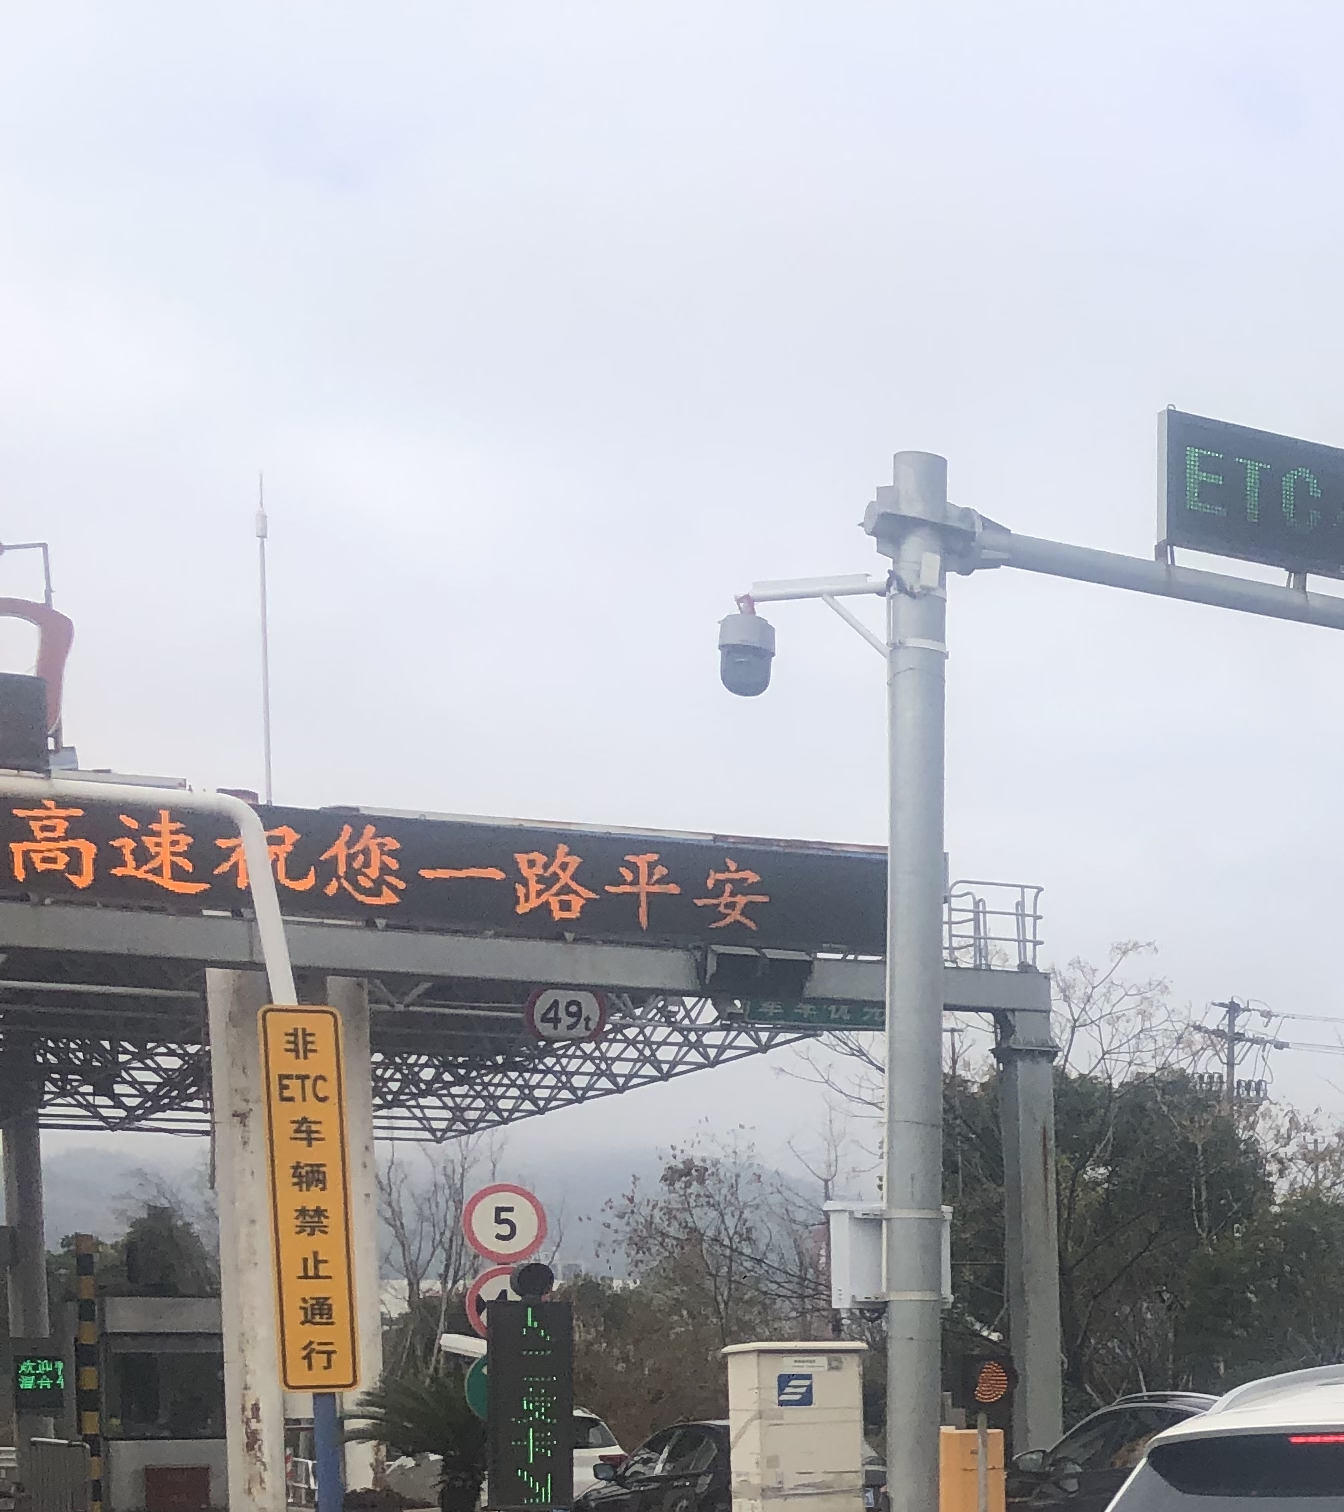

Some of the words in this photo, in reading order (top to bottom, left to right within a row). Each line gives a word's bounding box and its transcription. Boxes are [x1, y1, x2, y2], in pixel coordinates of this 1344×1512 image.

[8, 800, 771, 932] 高速祝您一路平安
[540, 999, 591, 1031] 49t
[277, 1027, 338, 1373] 非ETC车辆禁止通行
[494, 1206, 518, 1241] 5
